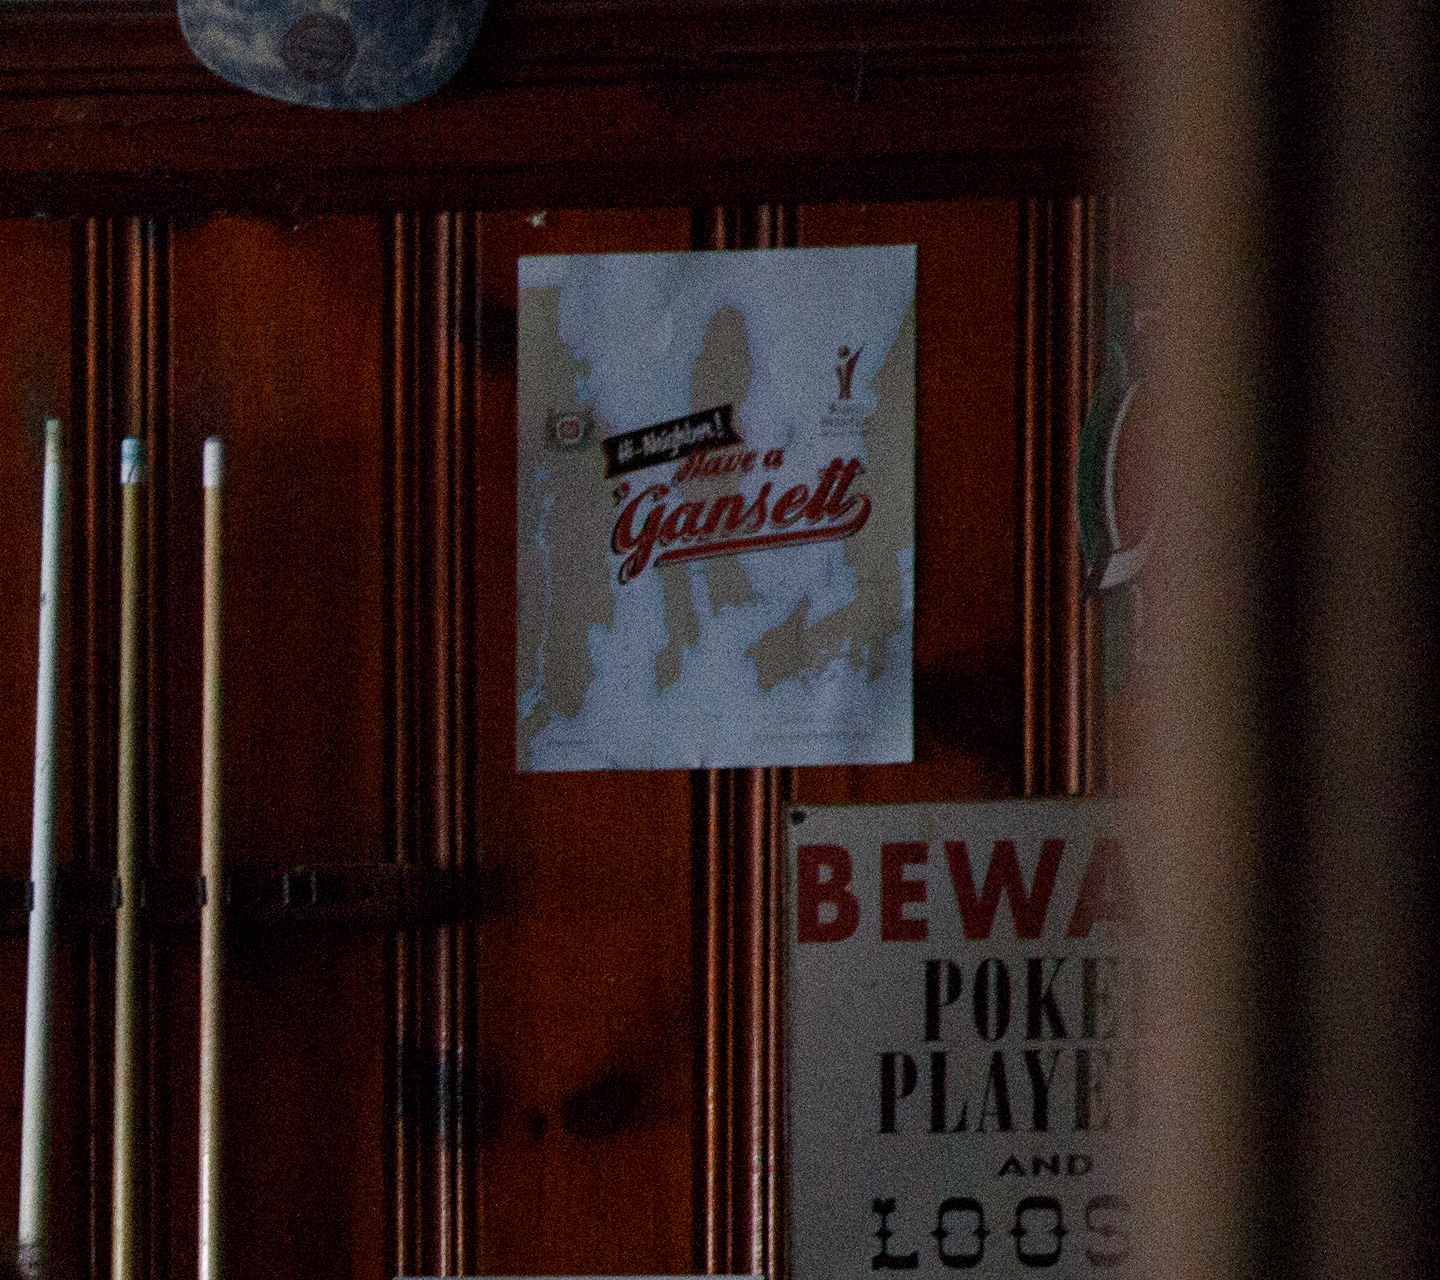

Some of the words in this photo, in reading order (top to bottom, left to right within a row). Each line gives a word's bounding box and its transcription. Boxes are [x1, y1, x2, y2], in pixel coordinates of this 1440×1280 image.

[878, 1049, 1117, 1133] PLAYE
[997, 1154, 1095, 1178] AND
[870, 1196, 1135, 1270] LOOS
